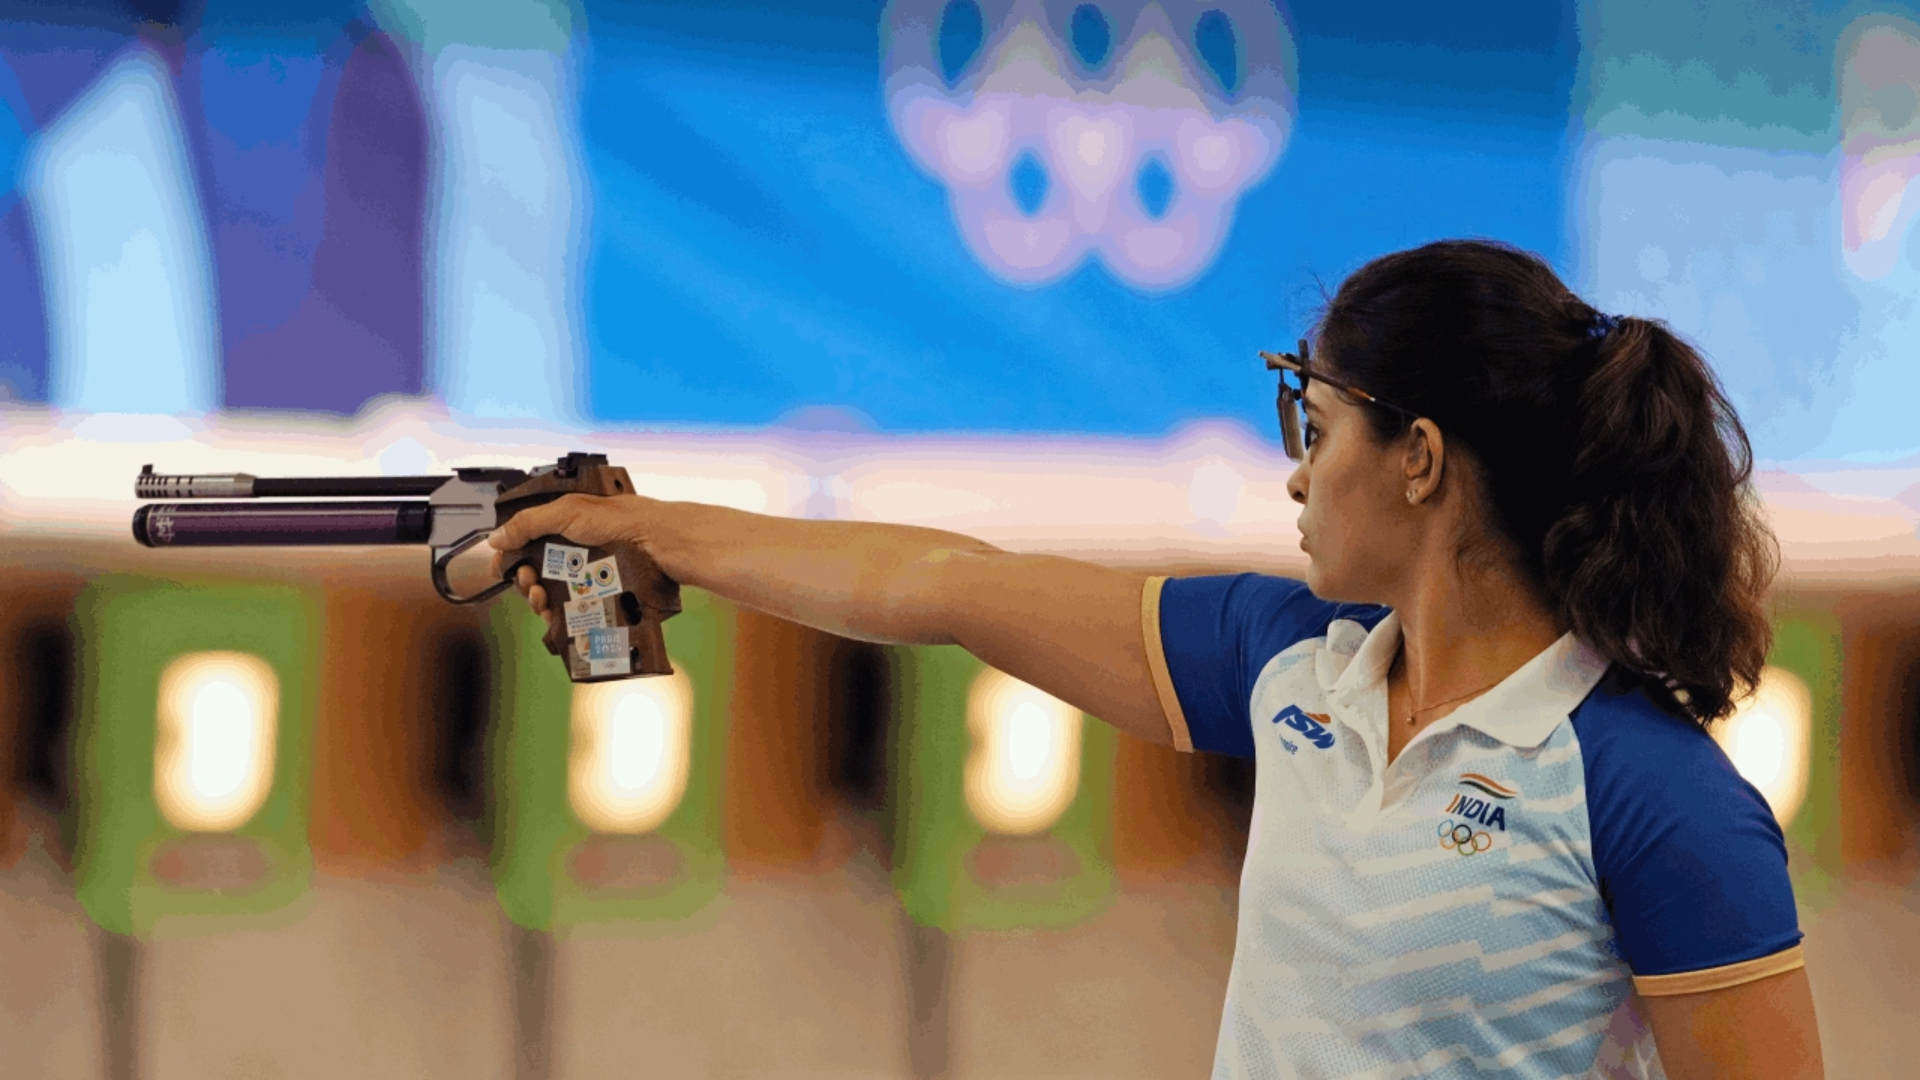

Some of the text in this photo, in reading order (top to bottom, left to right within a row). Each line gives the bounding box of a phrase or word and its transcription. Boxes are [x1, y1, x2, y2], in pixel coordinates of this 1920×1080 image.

[594, 634, 621, 645] PARIS
[594, 644, 622, 655] 2024
[1445, 793, 1505, 831] INDIA
